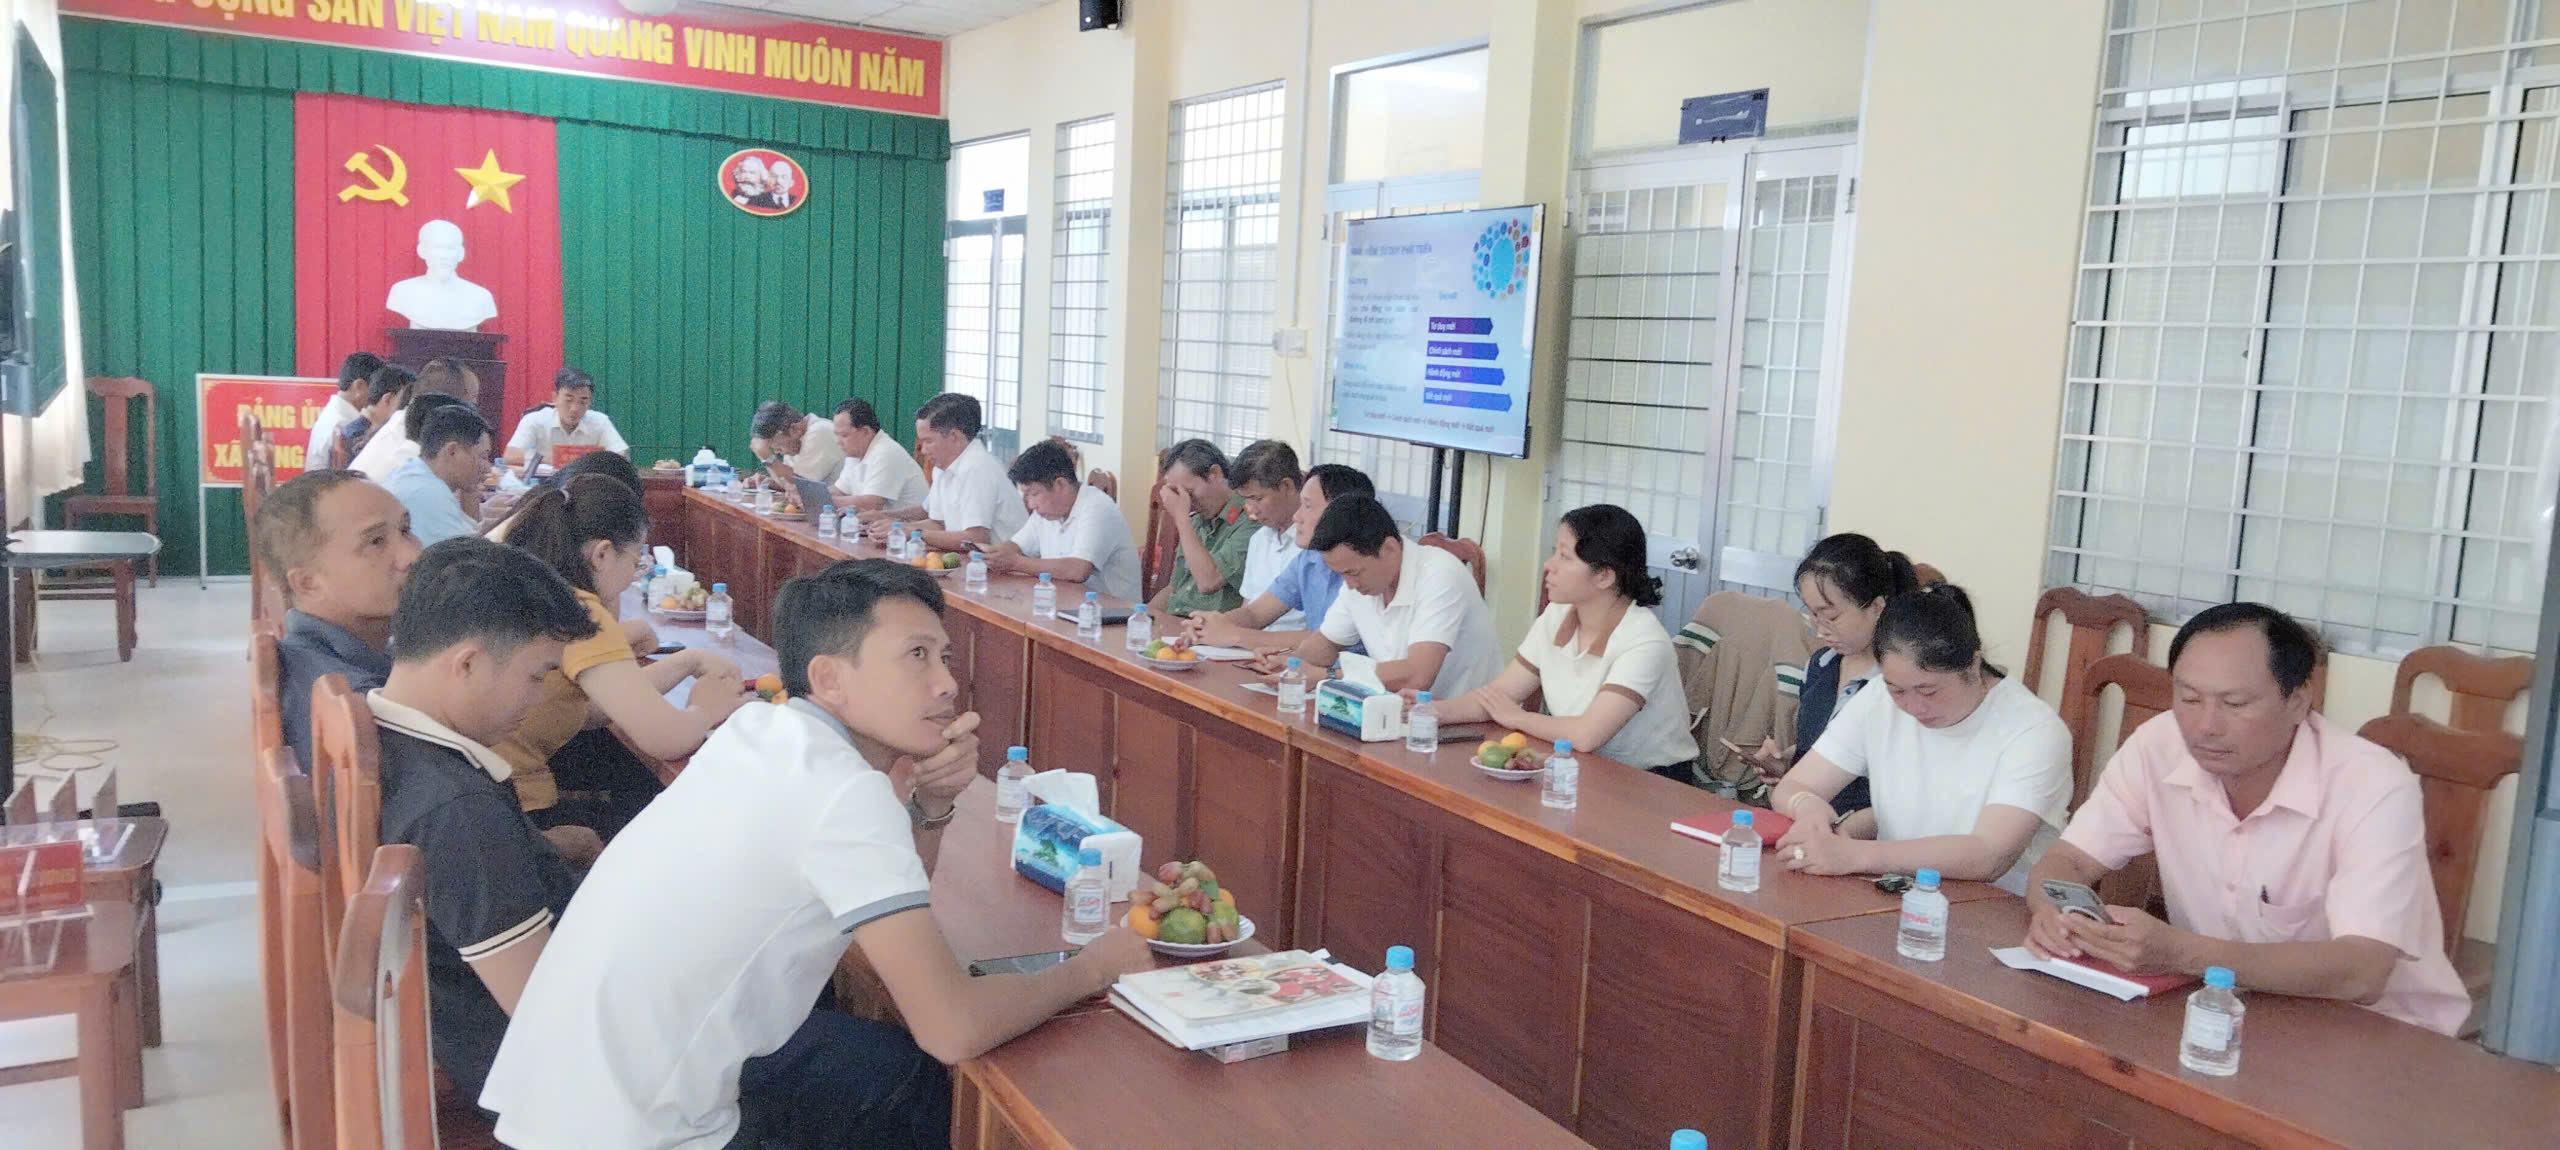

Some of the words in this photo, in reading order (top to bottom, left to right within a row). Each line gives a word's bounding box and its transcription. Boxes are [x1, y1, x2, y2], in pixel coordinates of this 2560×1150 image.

[476, 2, 556, 51] NAM
[565, 10, 674, 65] QUANG
[683, 27, 756, 75] VINH
[764, 36, 852, 88] MUÔN
[859, 47, 924, 97] NĂM
